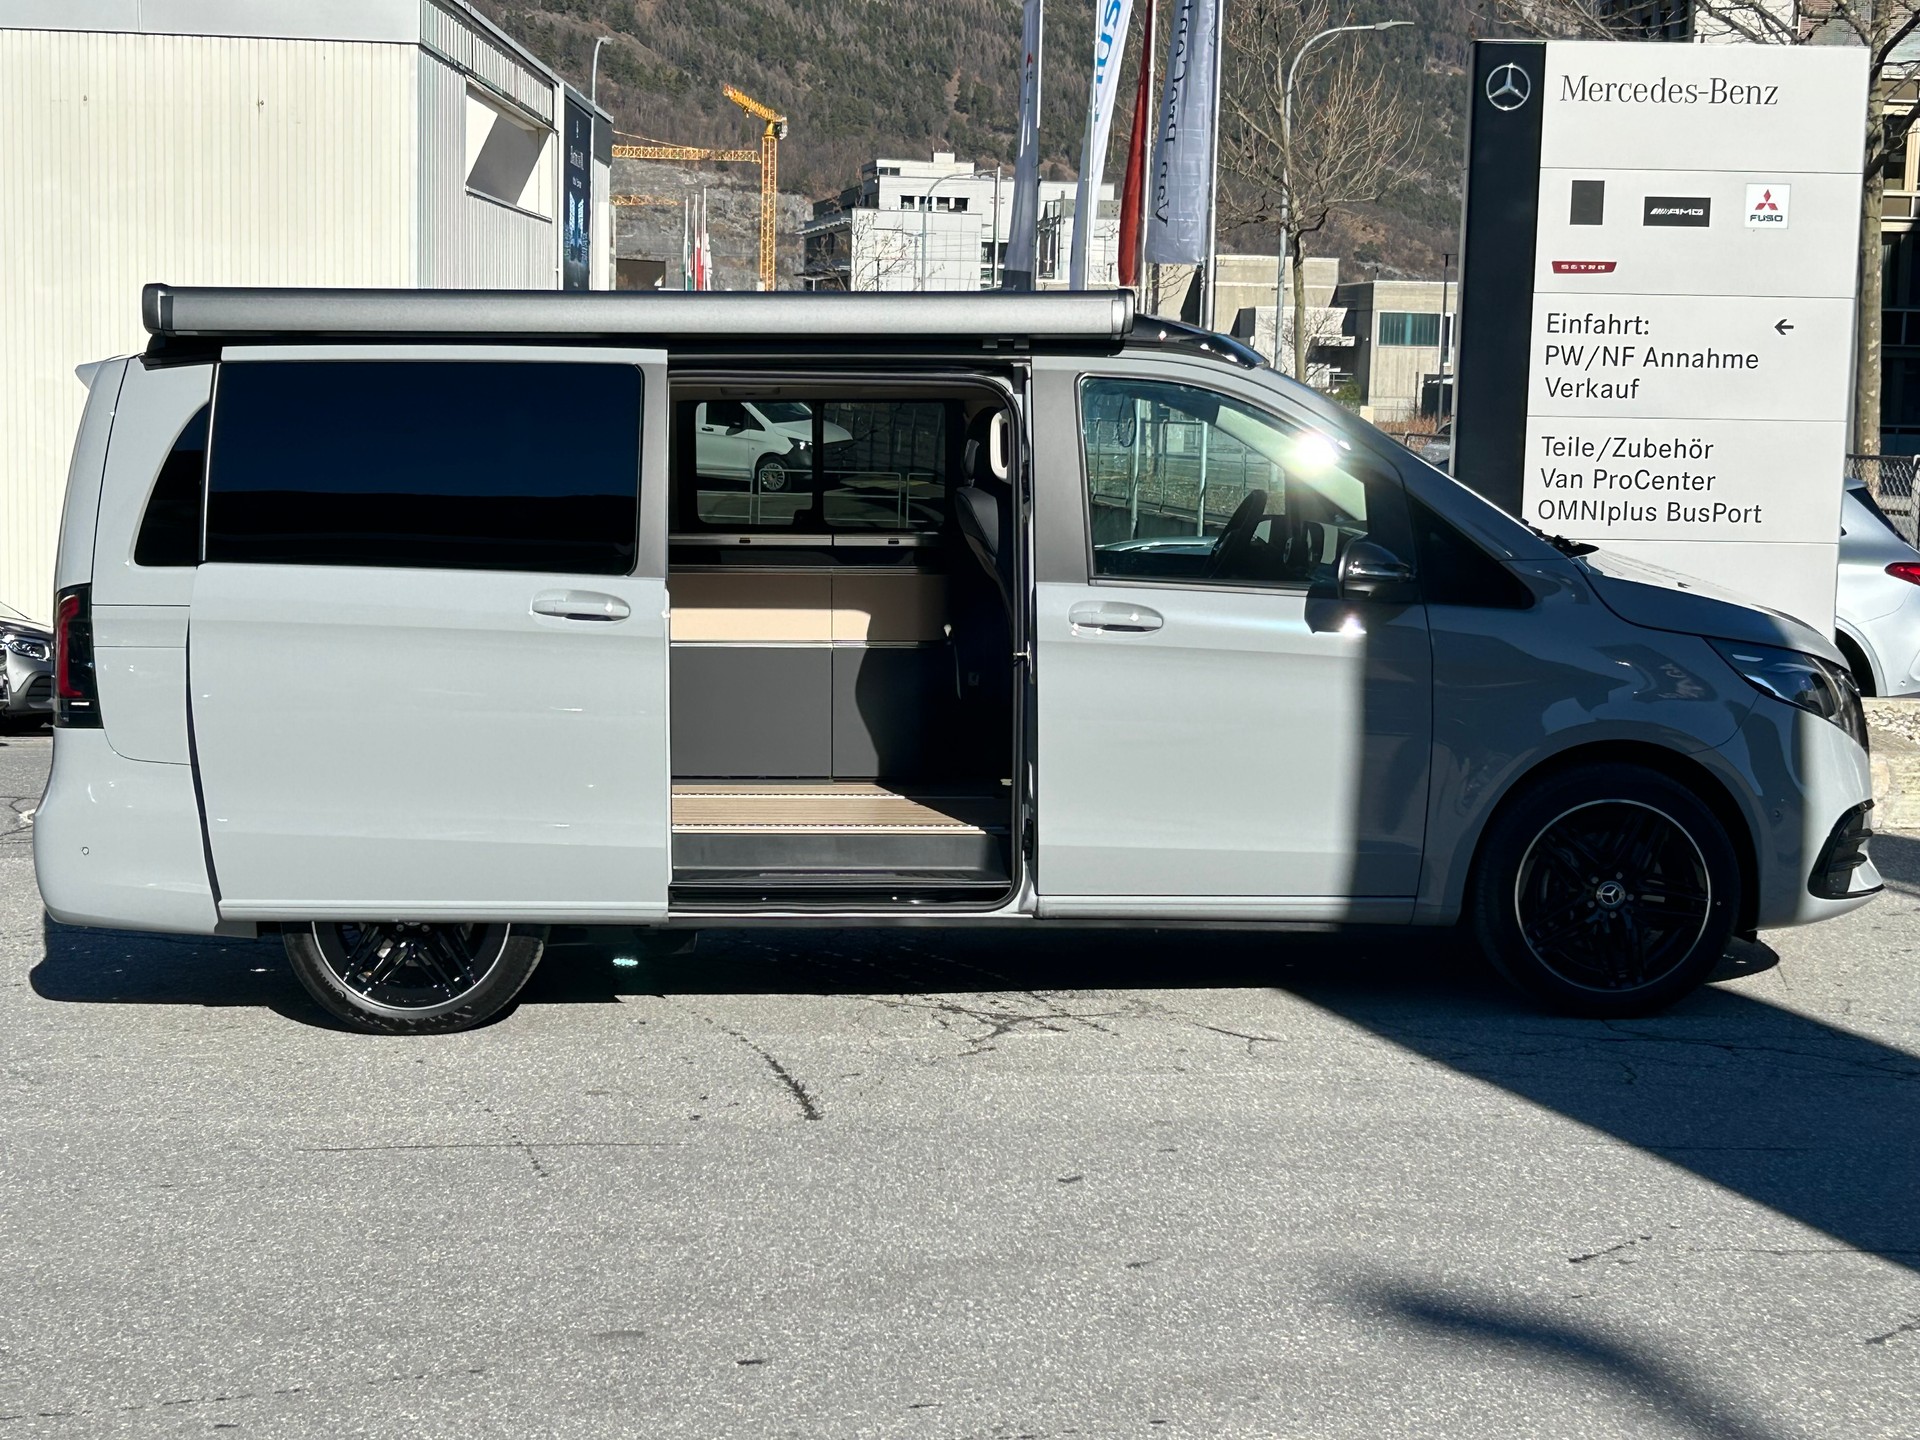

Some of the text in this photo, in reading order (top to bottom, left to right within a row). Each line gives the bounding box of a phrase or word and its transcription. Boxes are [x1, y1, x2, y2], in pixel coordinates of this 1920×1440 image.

[1560, 74, 1779, 105] Mercedes-Benz
[1750, 214, 1783, 222] FUSO
[1546, 312, 1649, 336] Einfahrt:
[1545, 344, 1760, 372] PW/NF Annahme
[1545, 376, 1640, 399] Verkauf
[1541, 435, 1714, 463] Teile/Zubehör
[1540, 467, 1717, 492] Van ProCenter
[1537, 499, 1763, 527] OMNIplus BusPort
